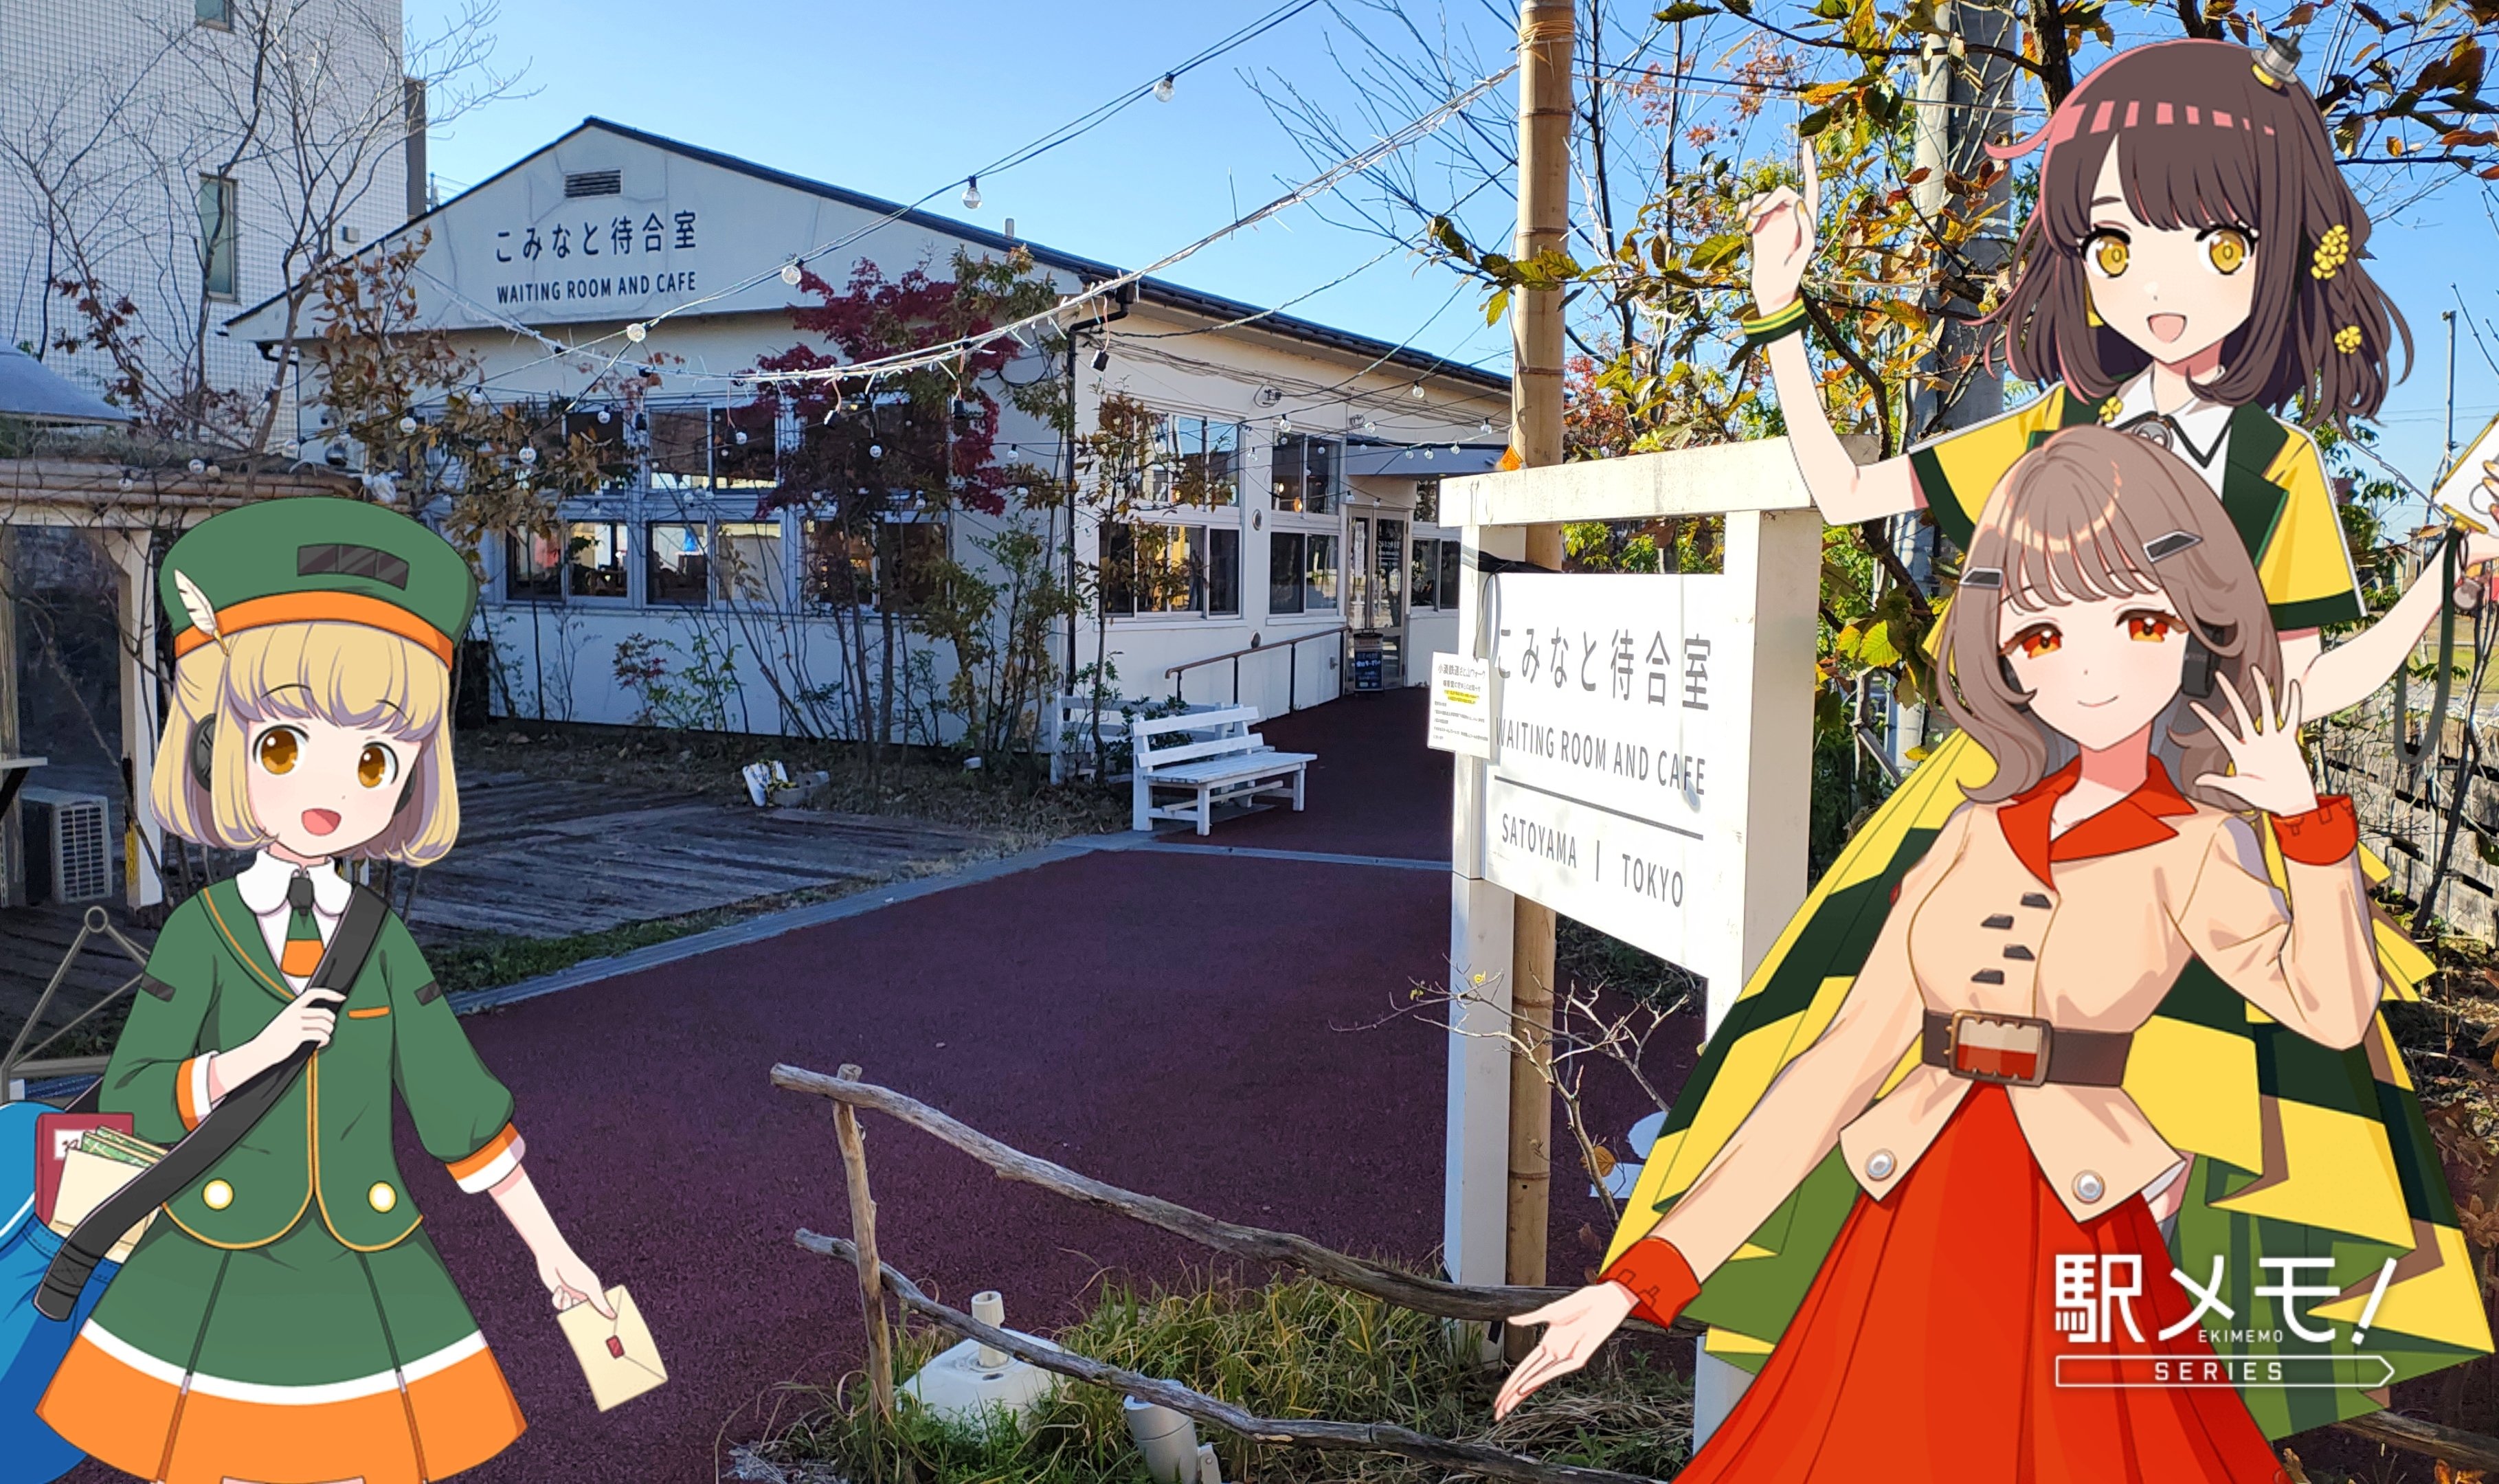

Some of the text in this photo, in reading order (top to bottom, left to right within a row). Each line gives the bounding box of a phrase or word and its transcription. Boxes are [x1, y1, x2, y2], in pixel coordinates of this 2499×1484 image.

[497, 210, 697, 262] こみなと待合室
[497, 271, 696, 304] WAITING ROOM AND CAFE
[1497, 627, 1711, 712] こみなと待合室
[1496, 716, 1705, 796] WAITING ROOM AND CAFE
[1501, 813, 1683, 908] SATOYAMA TOKYO
